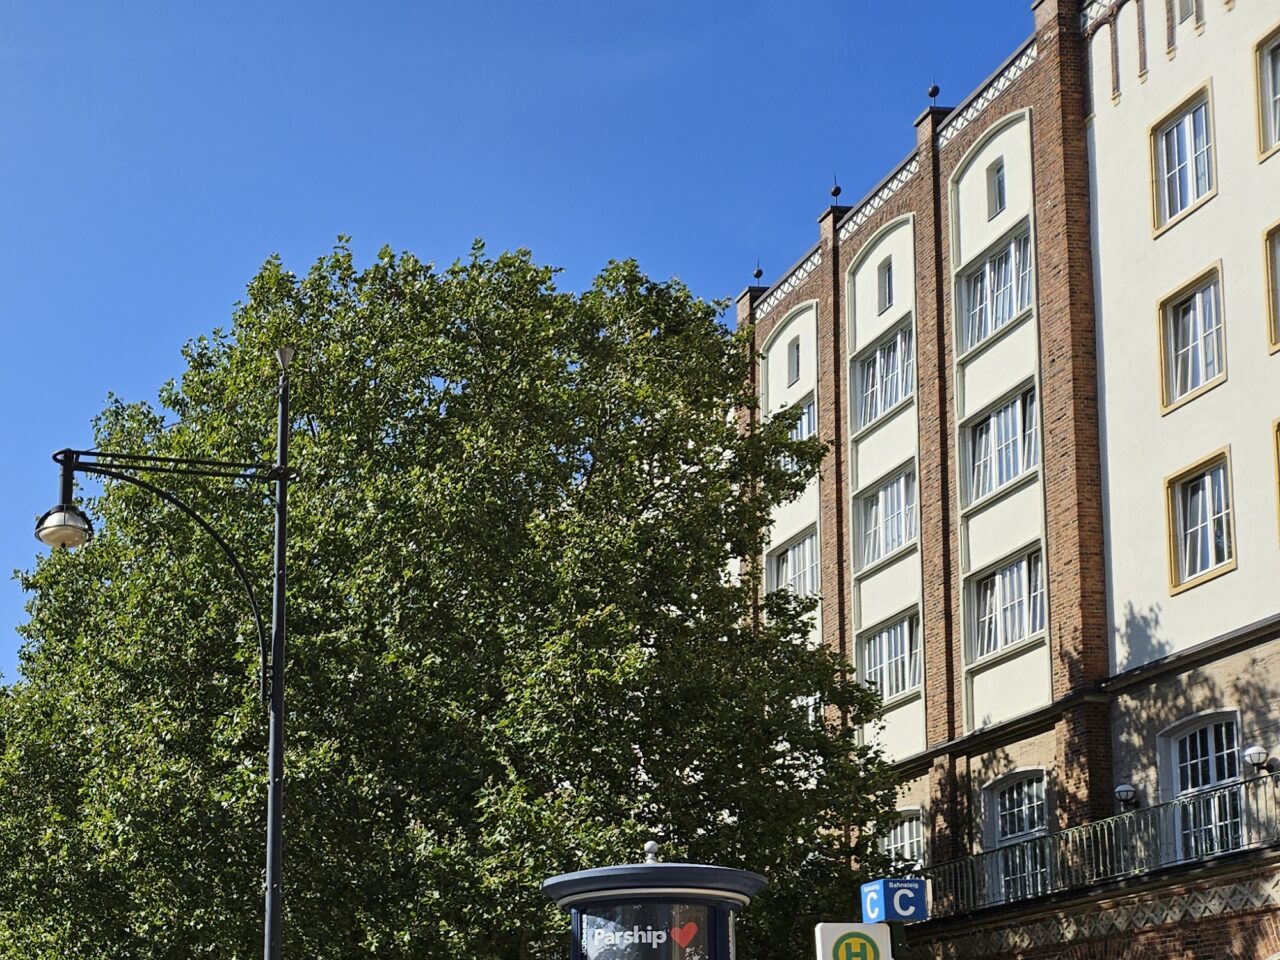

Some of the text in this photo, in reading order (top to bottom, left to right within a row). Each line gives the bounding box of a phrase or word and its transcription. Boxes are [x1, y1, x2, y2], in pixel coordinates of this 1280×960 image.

[888, 881, 919, 889] Bahnsteig
[866, 891, 880, 919] C
[893, 888, 916, 916] C
[594, 925, 667, 949] Parship
